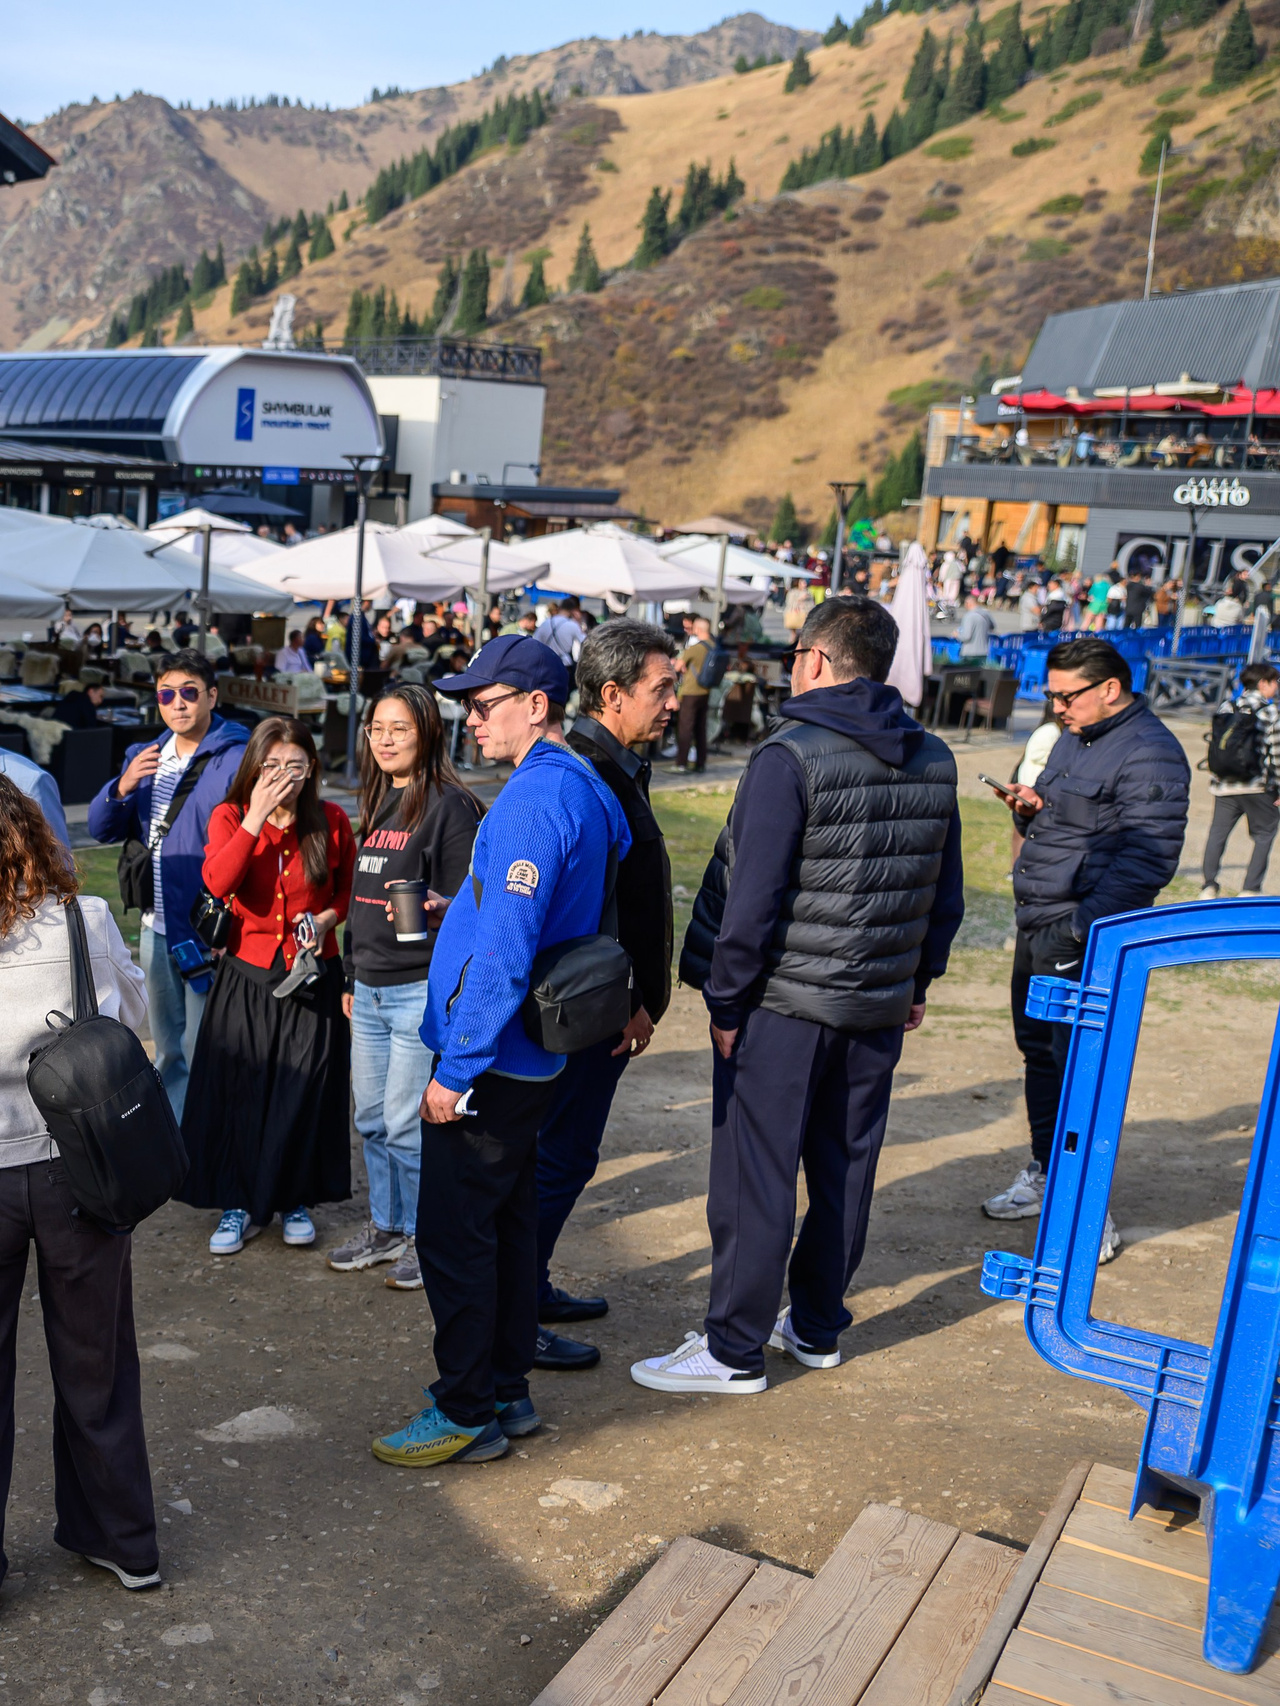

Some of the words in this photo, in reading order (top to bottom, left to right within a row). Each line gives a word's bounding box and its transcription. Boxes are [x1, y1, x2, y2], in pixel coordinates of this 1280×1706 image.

[262, 401, 333, 418] SHYMBULAK
[1173, 483, 1250, 506] GUSTO
[227, 682, 289, 704] CHALET
[405, 1434, 461, 1455] DYNAFIT
